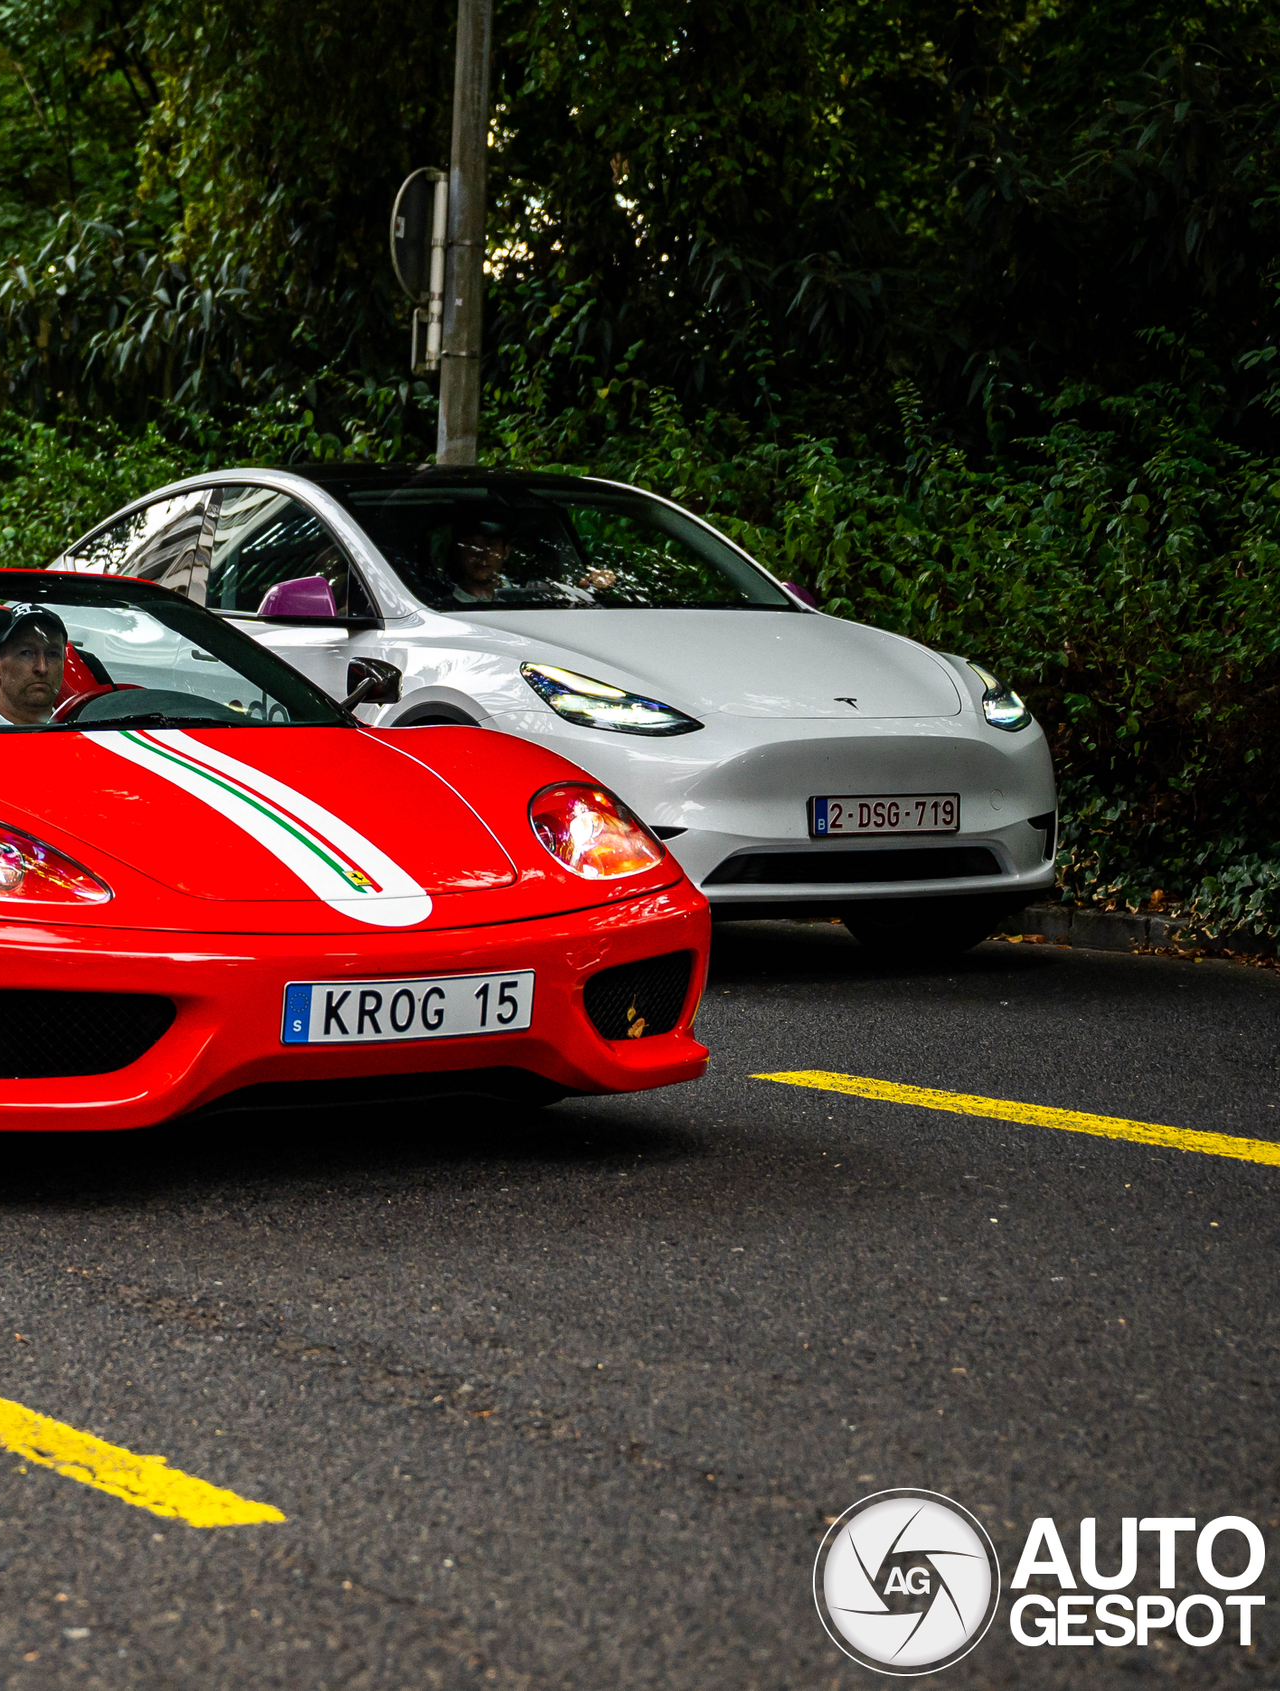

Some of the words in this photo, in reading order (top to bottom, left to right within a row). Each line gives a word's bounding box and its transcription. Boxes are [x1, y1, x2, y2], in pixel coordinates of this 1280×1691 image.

[818, 818, 826, 830] B
[323, 986, 446, 1035] KROG
[474, 980, 519, 1027] 15
[292, 1020, 302, 1032] S
